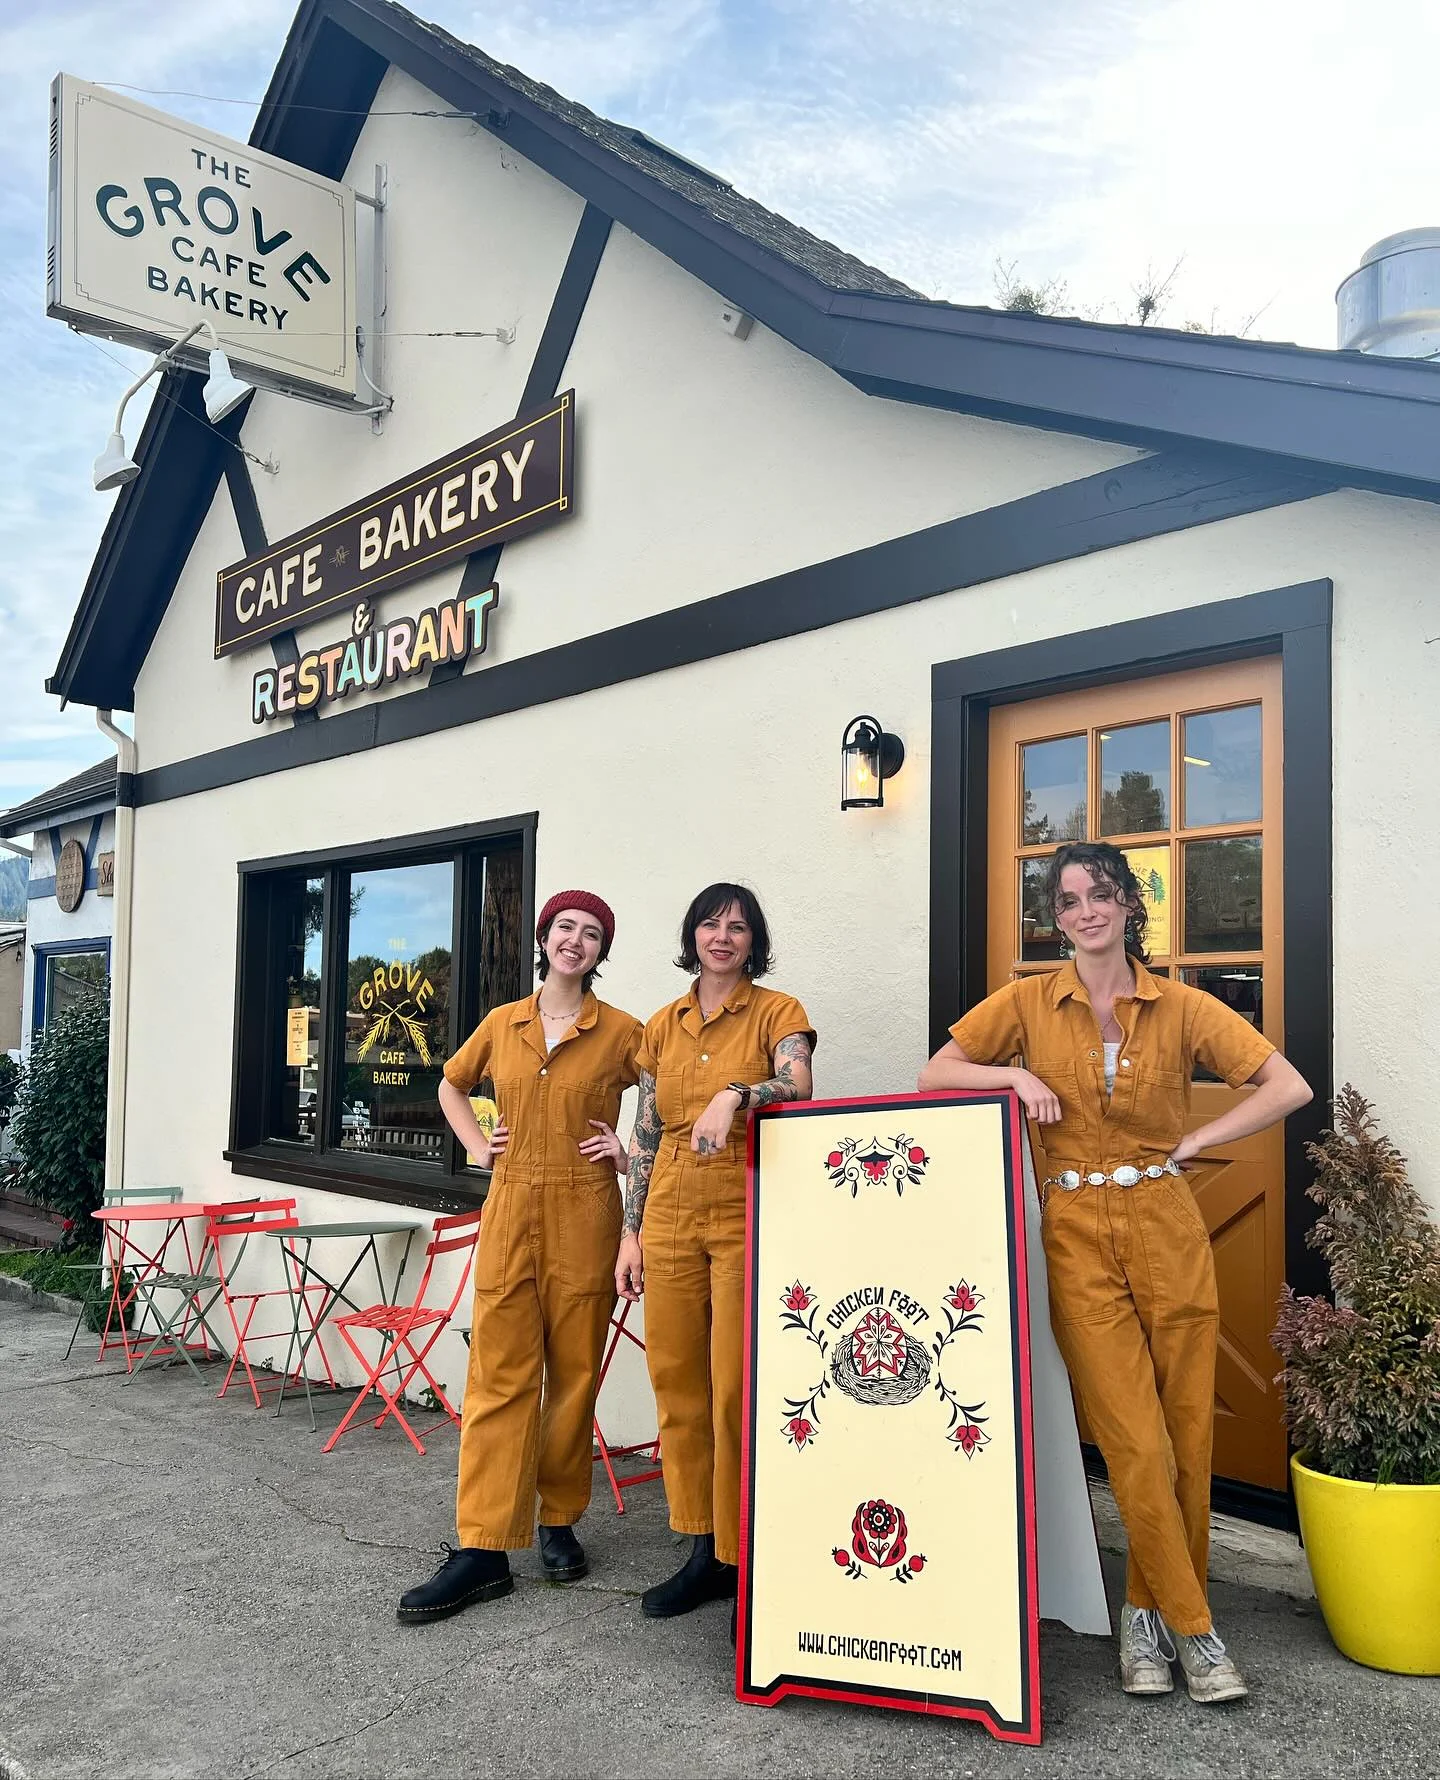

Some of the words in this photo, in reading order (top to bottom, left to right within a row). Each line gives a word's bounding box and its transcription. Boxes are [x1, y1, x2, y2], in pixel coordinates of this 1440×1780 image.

[191, 148, 251, 189] THE
[95, 176, 332, 303] GROVE
[171, 236, 267, 288] CAFE
[147, 265, 289, 331] BAKERY
[234, 543, 323, 624] CAFE
[359, 439, 535, 571] BAKERY
[353, 602, 370, 636] &
[253, 588, 495, 722] RESTAURANT
[359, 959, 435, 1013] GROVE
[373, 1071, 411, 1086] BAKERY
[380, 1050, 405, 1065] CAFE
[826, 1286, 884, 1330] CHICKEN
[888, 1289, 930, 1326] FOOT
[798, 1631, 962, 1672] WWW.CHICKENFOOT.COM
